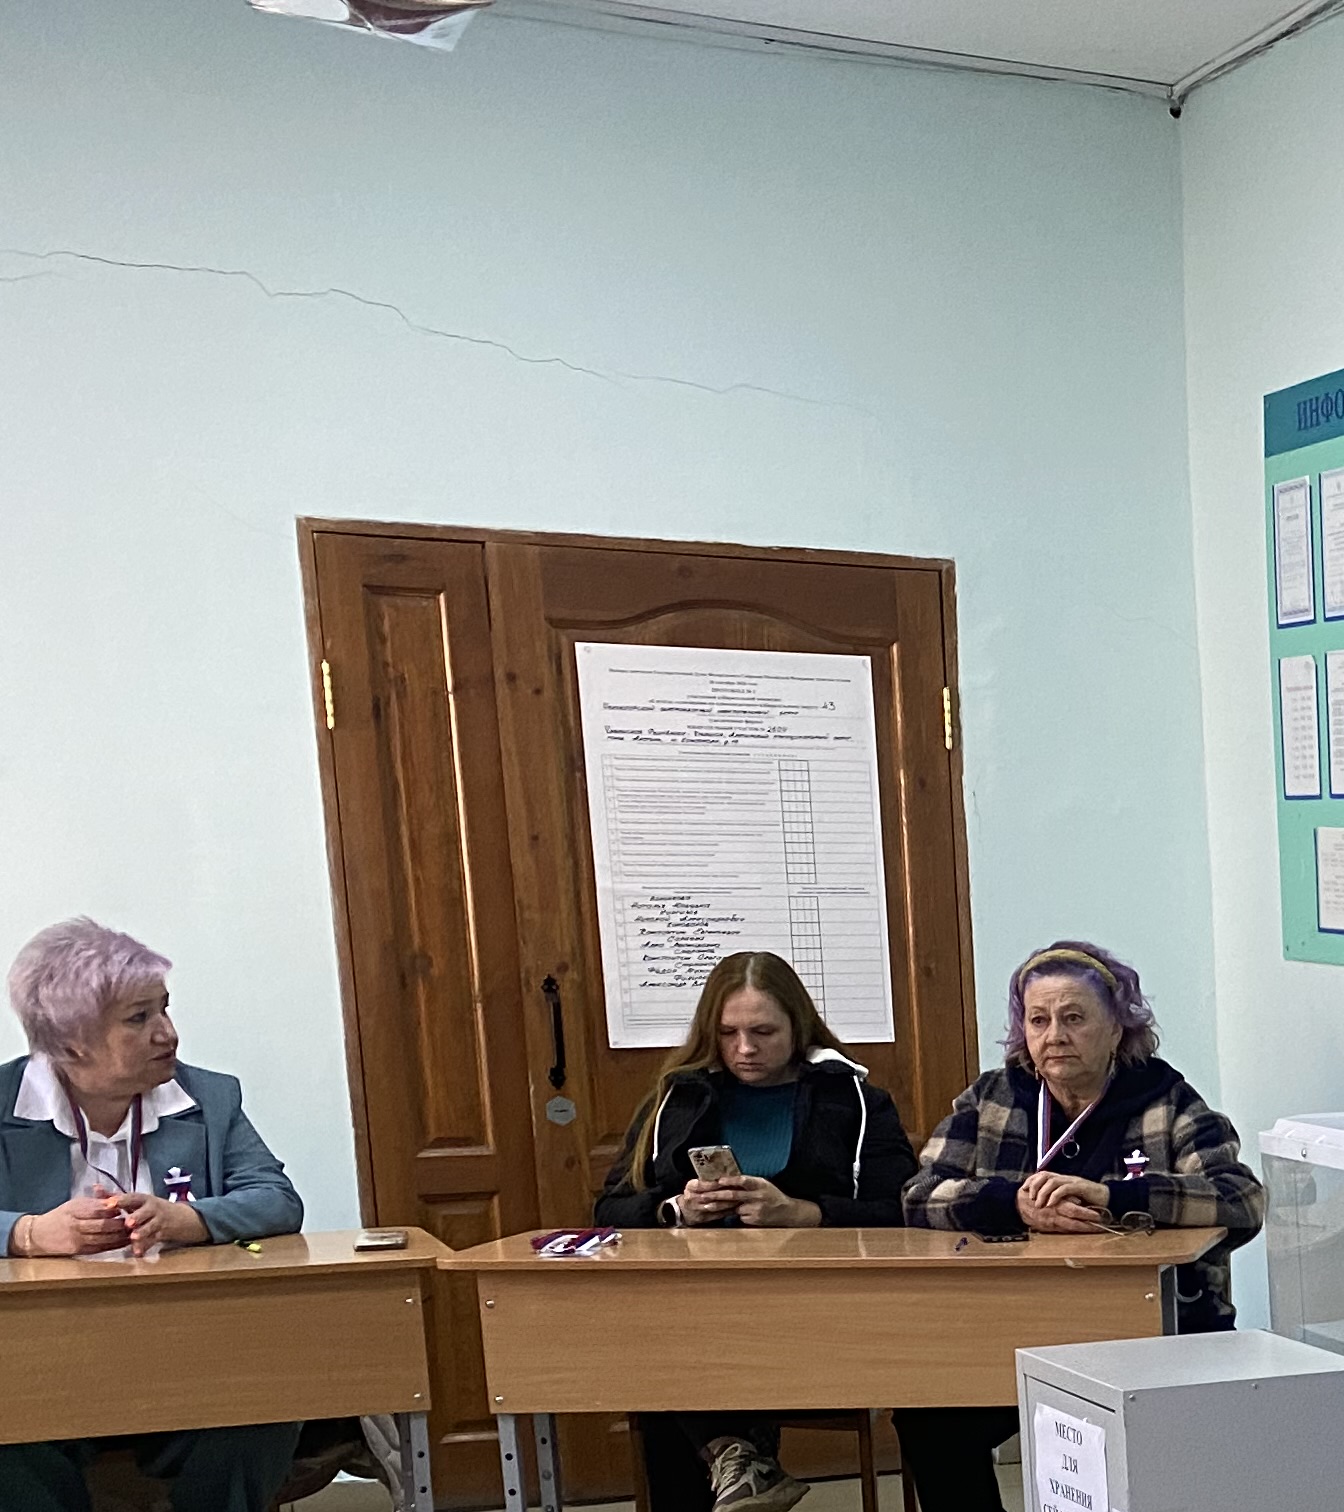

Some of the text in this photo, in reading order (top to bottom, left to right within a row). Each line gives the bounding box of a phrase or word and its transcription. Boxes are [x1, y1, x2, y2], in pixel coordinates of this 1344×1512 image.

[1055, 1420, 1083, 1446] МЕСТО
[1061, 1454, 1078, 1474] ДЛЯ
[1049, 1478, 1093, 1511] ХРАНЕНИЯ
